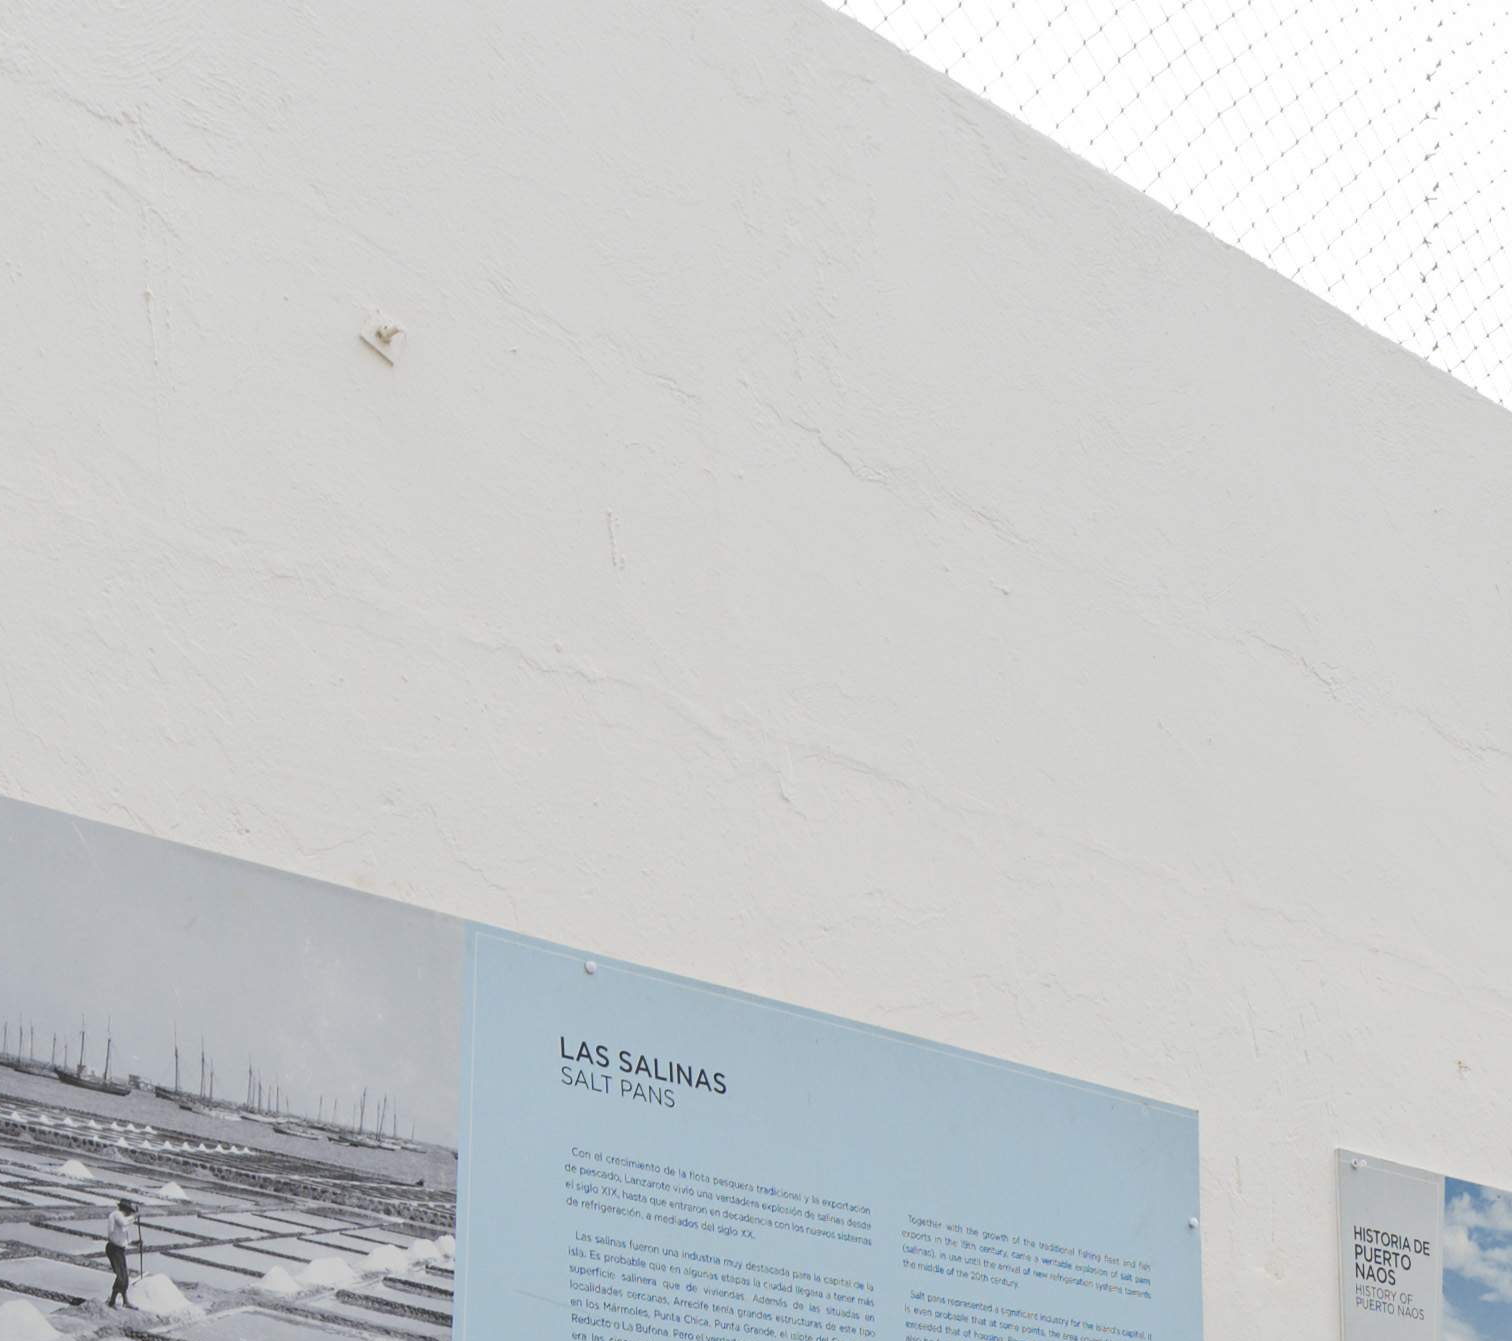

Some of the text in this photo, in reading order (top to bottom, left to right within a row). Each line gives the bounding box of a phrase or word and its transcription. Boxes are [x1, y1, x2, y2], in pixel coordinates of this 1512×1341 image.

[560, 1035, 727, 1095] LAS SALINAS
[561, 1065, 675, 1108] SALT PANS
[1353, 1225, 1430, 1257] HISTORIA DE
[1354, 1243, 1412, 1271] PUERTO
[1354, 1261, 1396, 1286] NAOS
[1355, 1282, 1413, 1305] HISTORY OF
[1355, 1295, 1425, 1321] PUERTO NAOS
